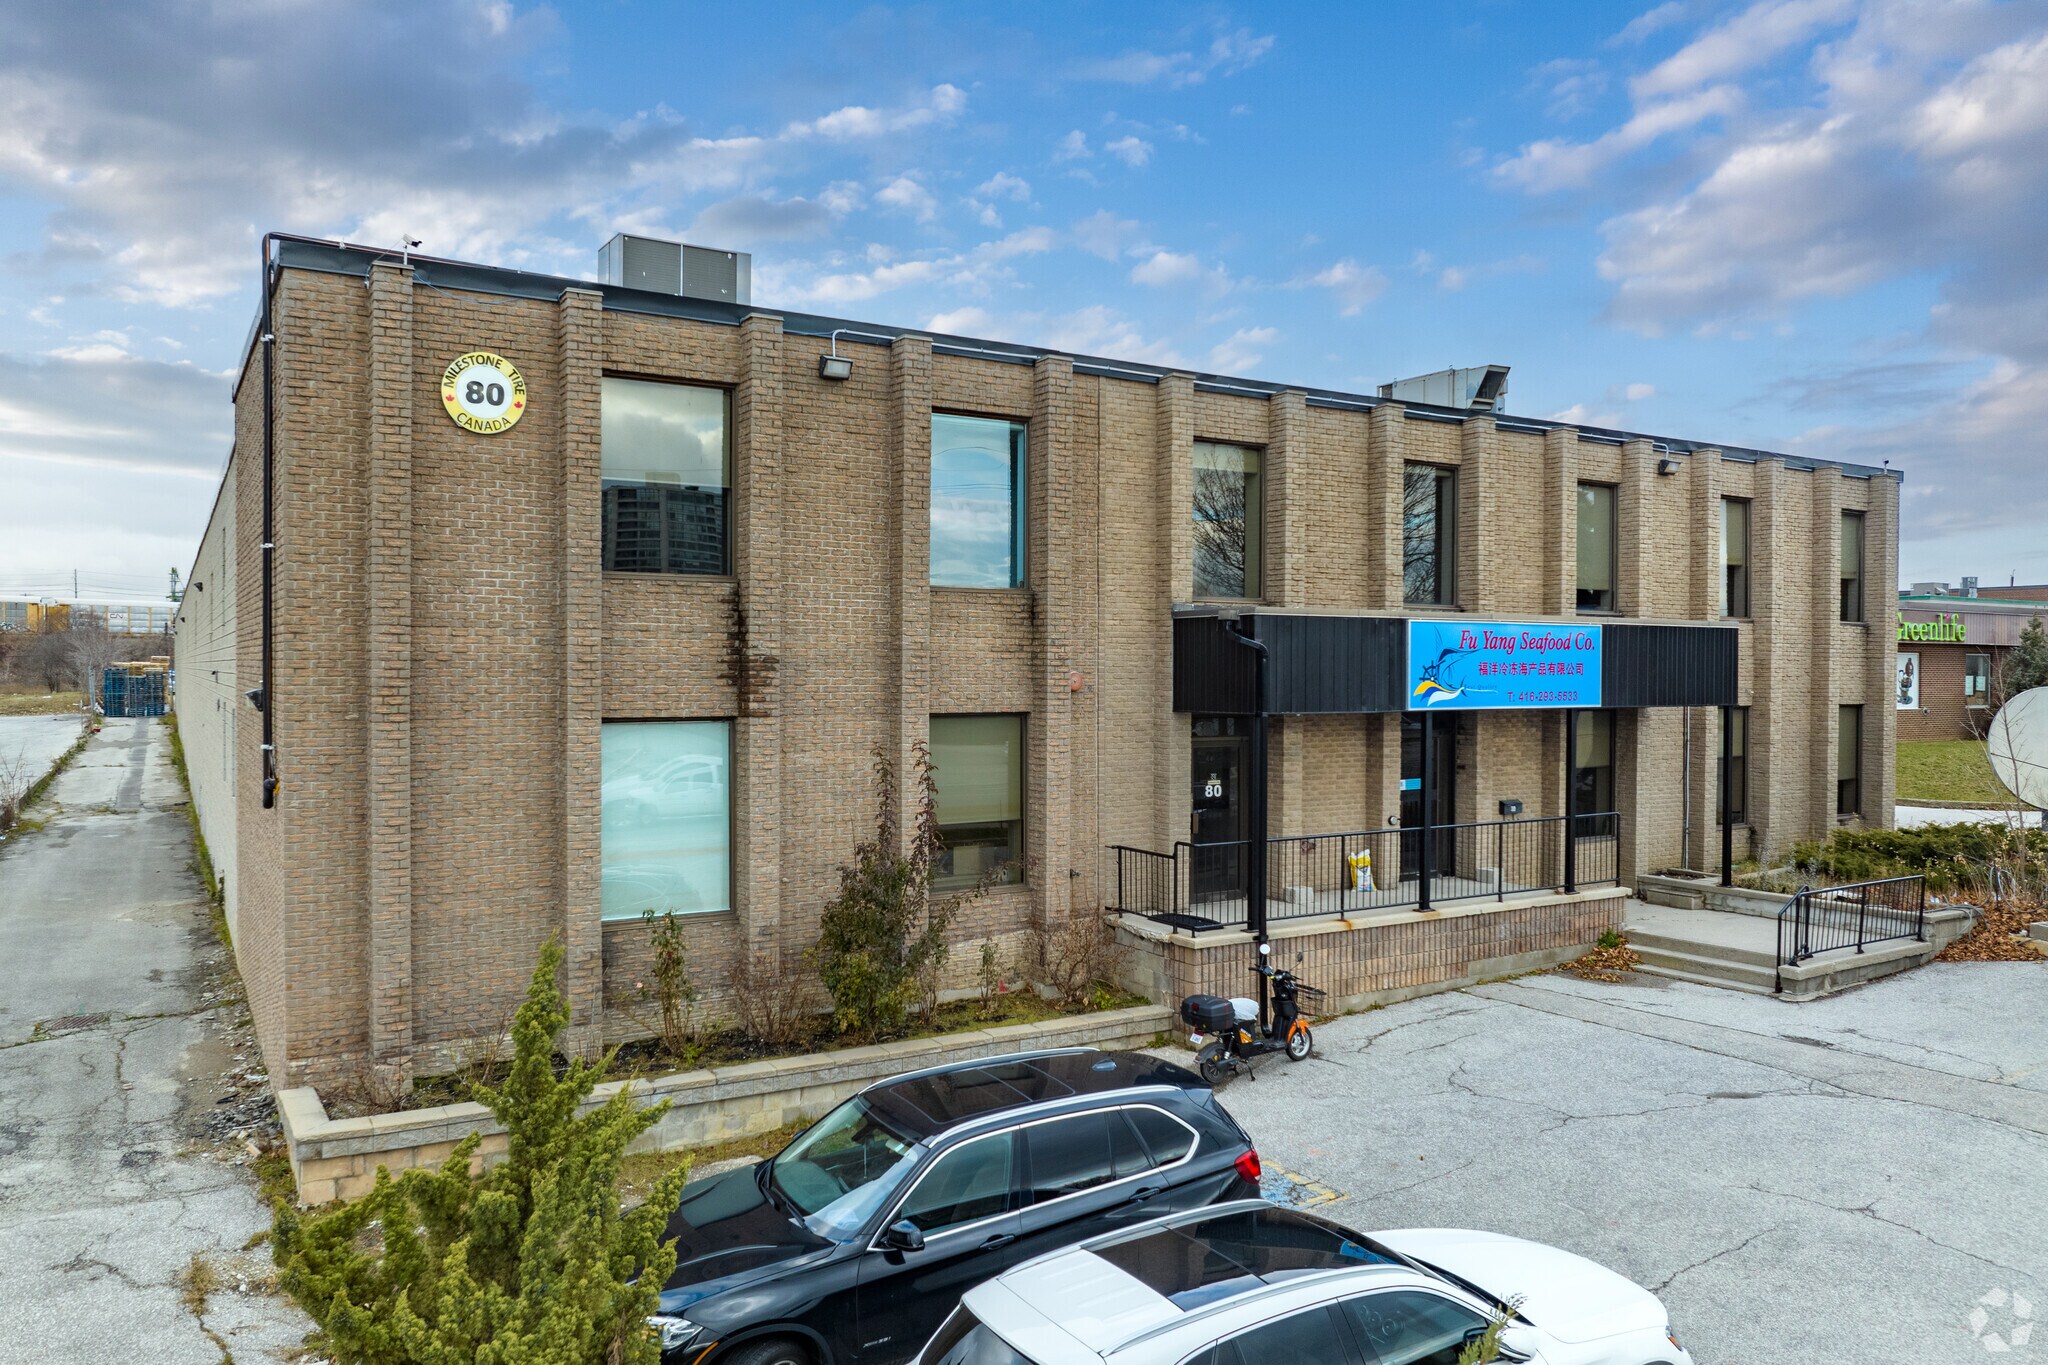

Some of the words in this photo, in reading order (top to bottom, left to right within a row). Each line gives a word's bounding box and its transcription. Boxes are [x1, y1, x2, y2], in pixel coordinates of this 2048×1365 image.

[443, 354, 503, 388] MILESTONE
[508, 369, 525, 395] TIRE
[465, 380, 505, 406] 80
[457, 412, 512, 431] CANADA
[1459, 630, 1478, 650] Fu
[1483, 630, 1517, 655] Yang
[1520, 631, 1573, 655] Seafood
[1575, 632, 1595, 651] Co.
[1478, 662, 1584, 676] 福洋冷冻海产品有限公司
[1508, 691, 1515, 702] T:
[1519, 691, 1578, 702] 416-293-5533
[1205, 785, 1222, 797] 80
